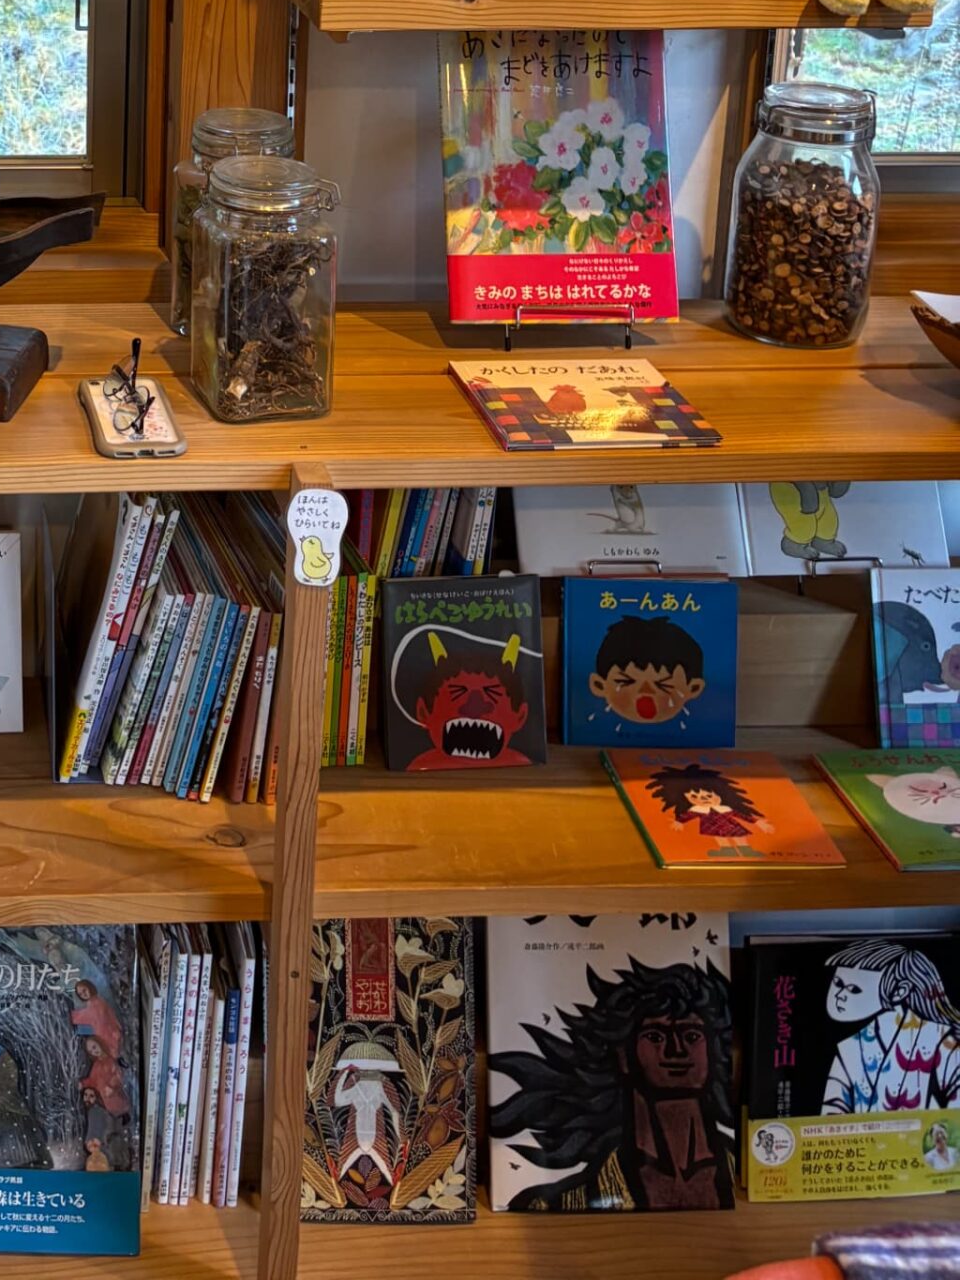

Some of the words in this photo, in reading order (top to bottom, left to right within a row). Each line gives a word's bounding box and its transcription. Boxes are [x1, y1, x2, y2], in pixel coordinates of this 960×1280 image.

[500, 48, 652, 86] まどをあけますよ
[473, 285, 517, 301] きみの
[520, 285, 563, 300] まちは
[567, 284, 652, 300] はれてるかな
[480, 365, 569, 376] かくしたの
[575, 365, 640, 374] だあれ
[297, 494, 329, 505] ほんは
[296, 507, 330, 518] やさしく
[294, 519, 341, 530] ひらいてね
[603, 547, 640, 556] しもかわら
[643, 547, 660, 556] ゆみ
[599, 591, 701, 611] あーんあん
[904, 586, 960, 604] たべた
[395, 597, 533, 624] はらぺこゆうれい
[354, 591, 366, 668] わたしのワンピース
[188, 963, 199, 998] つるの
[773, 976, 796, 1068] 花さき山
[801, 1147, 867, 1162] 誰かのために
[801, 1157, 926, 1176] 何かをすることができる。
